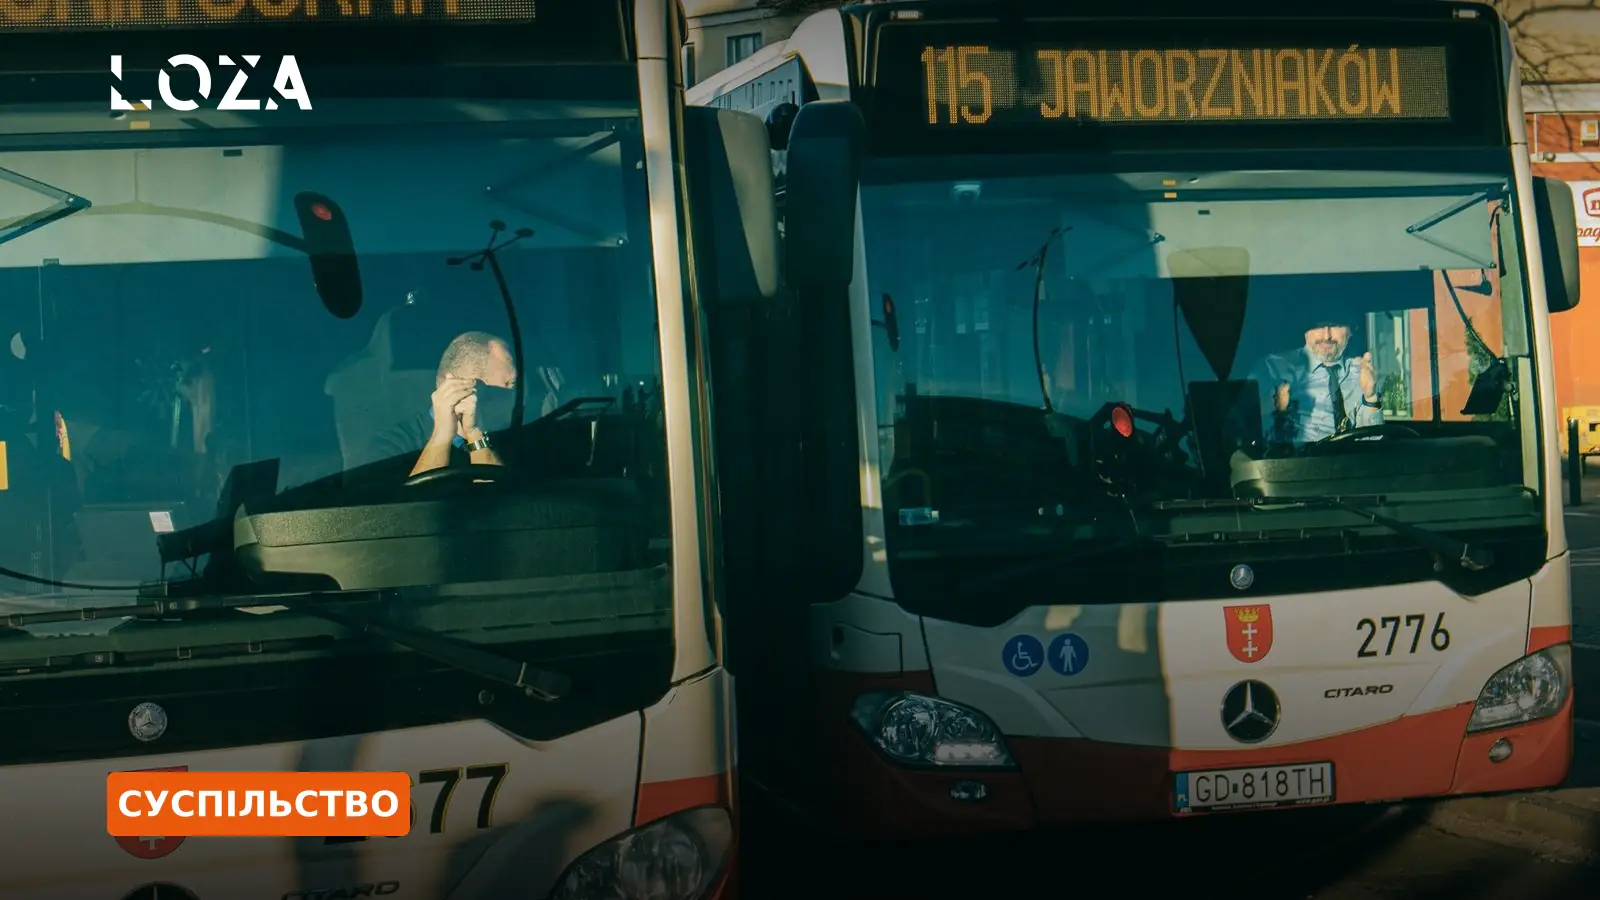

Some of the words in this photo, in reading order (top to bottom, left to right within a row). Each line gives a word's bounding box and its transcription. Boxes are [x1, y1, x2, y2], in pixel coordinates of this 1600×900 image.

[921, 46, 992, 124] 115
[1036, 44, 1401, 118] JAWORZNIAKÓW
[1356, 612, 1451, 658] 2776
[1324, 684, 1394, 699] CITARO
